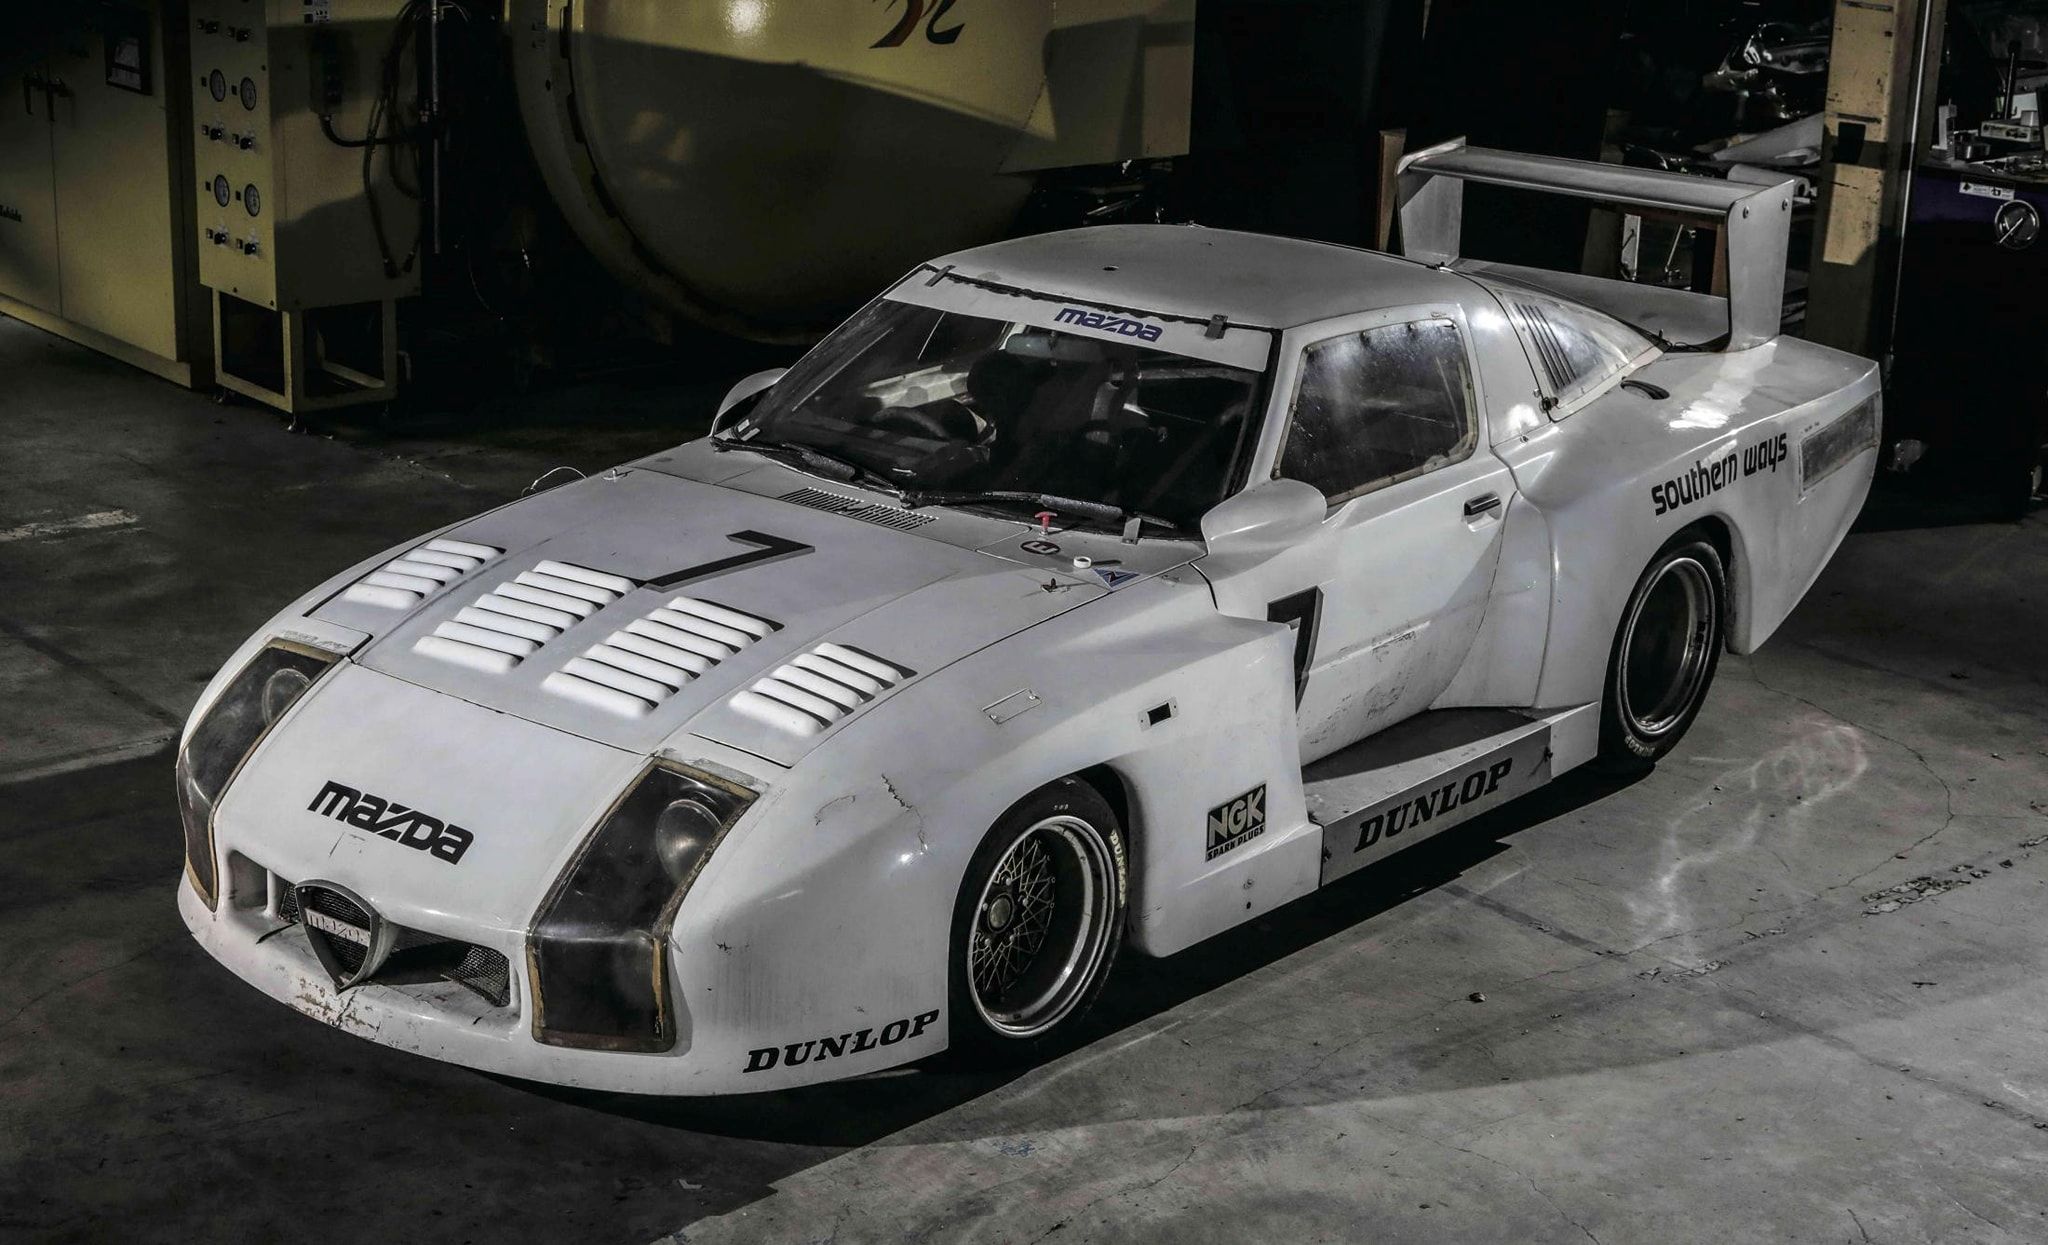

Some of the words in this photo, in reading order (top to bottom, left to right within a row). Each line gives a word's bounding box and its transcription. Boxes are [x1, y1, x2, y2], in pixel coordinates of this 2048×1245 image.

[1054, 308, 1163, 342] mazda
[1651, 453, 1738, 516] southern
[1744, 433, 1787, 477] ways
[645, 530, 815, 593] 7
[1266, 586, 1324, 714] 7
[307, 780, 474, 865] mazda
[1208, 787, 1264, 848] NGK
[1354, 757, 1513, 853] DUNLOP
[1207, 840, 1236, 860] SPARK
[1237, 824, 1264, 845] PLUGS
[743, 1009, 940, 1073] DUNLOP
